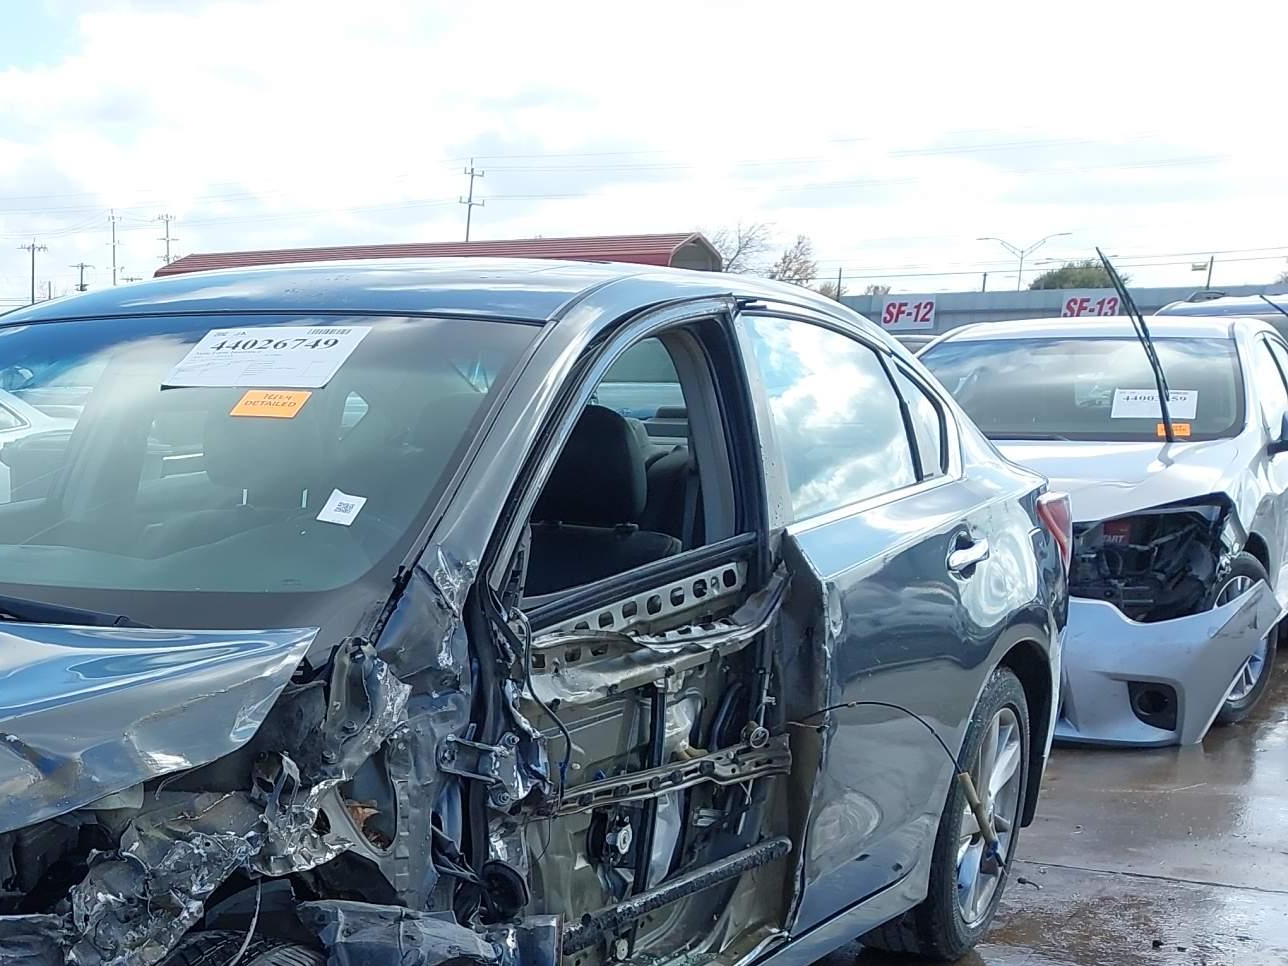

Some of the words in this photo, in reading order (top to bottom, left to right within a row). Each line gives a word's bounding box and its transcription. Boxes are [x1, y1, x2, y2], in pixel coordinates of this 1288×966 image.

[883, 302, 934, 324] SF-12
[1063, 297, 1118, 317] SF-13
[210, 338, 340, 351] 44026749
[244, 400, 297, 408] DETAILED
